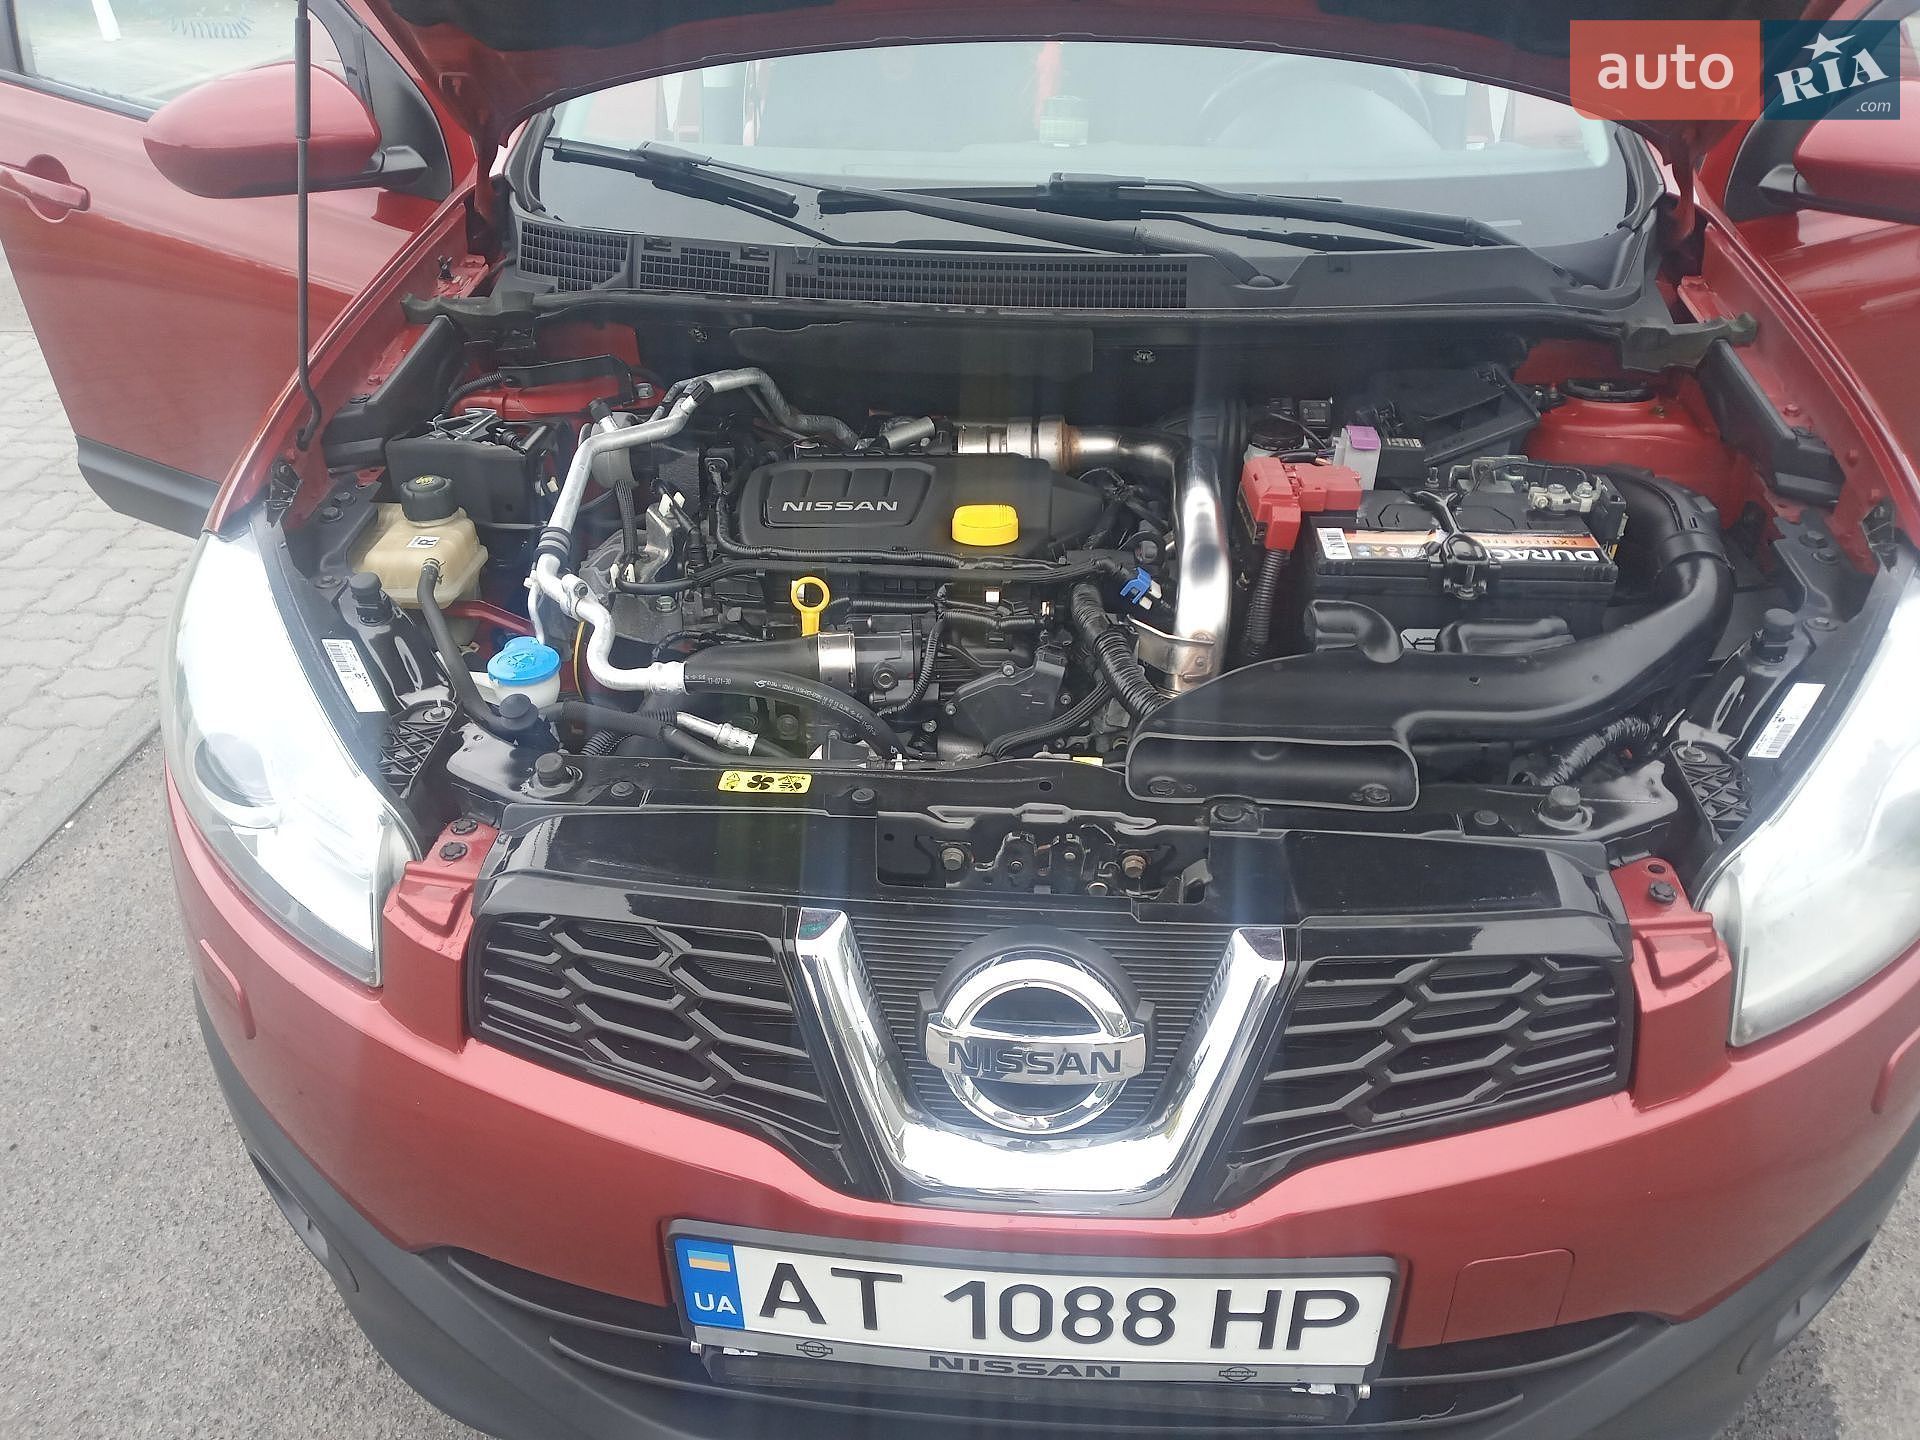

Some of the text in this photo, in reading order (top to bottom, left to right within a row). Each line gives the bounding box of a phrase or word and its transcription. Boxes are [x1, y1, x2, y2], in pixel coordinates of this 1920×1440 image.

[781, 501, 898, 512] NISSAN
[948, 1042, 1122, 1076] NISSAN
[694, 1292, 737, 1314] UA
[759, 1262, 1360, 1350] AT 1088 HP
[929, 1355, 1121, 1379] NISSAN
